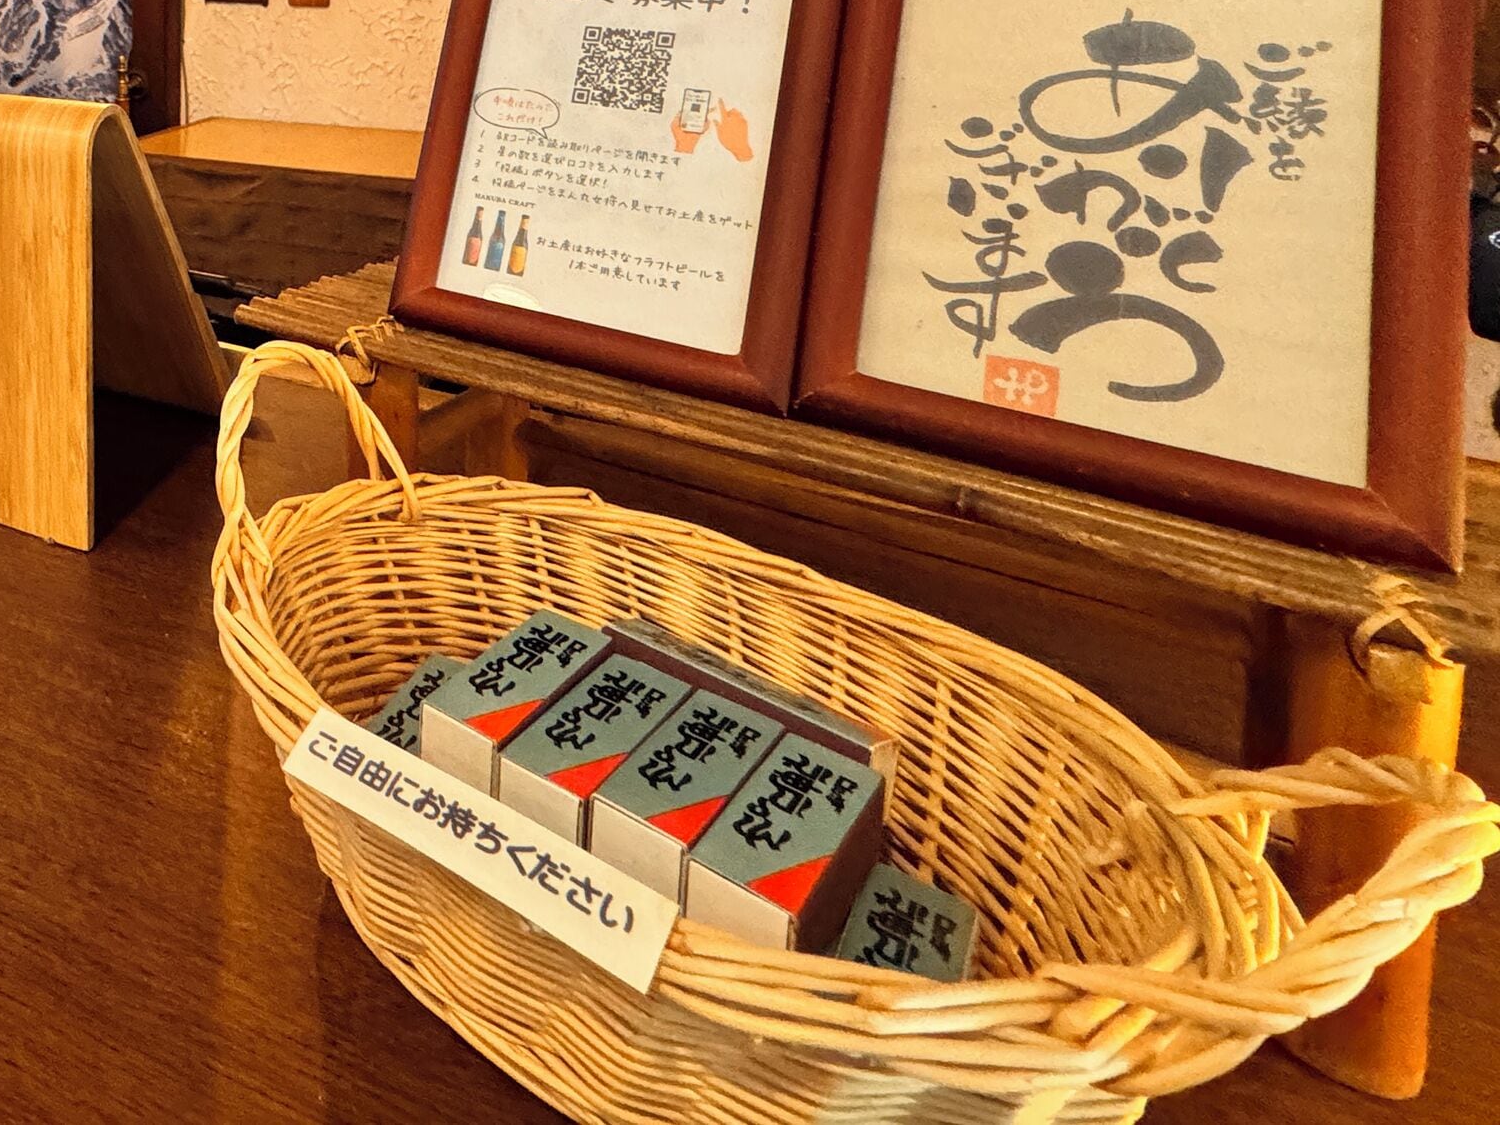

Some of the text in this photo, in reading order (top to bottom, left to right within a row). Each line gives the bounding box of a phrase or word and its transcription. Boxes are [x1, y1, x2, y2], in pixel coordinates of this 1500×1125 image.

[508, 198, 537, 209] CRAFT
[308, 730, 634, 933] ご自由にお持ちください
